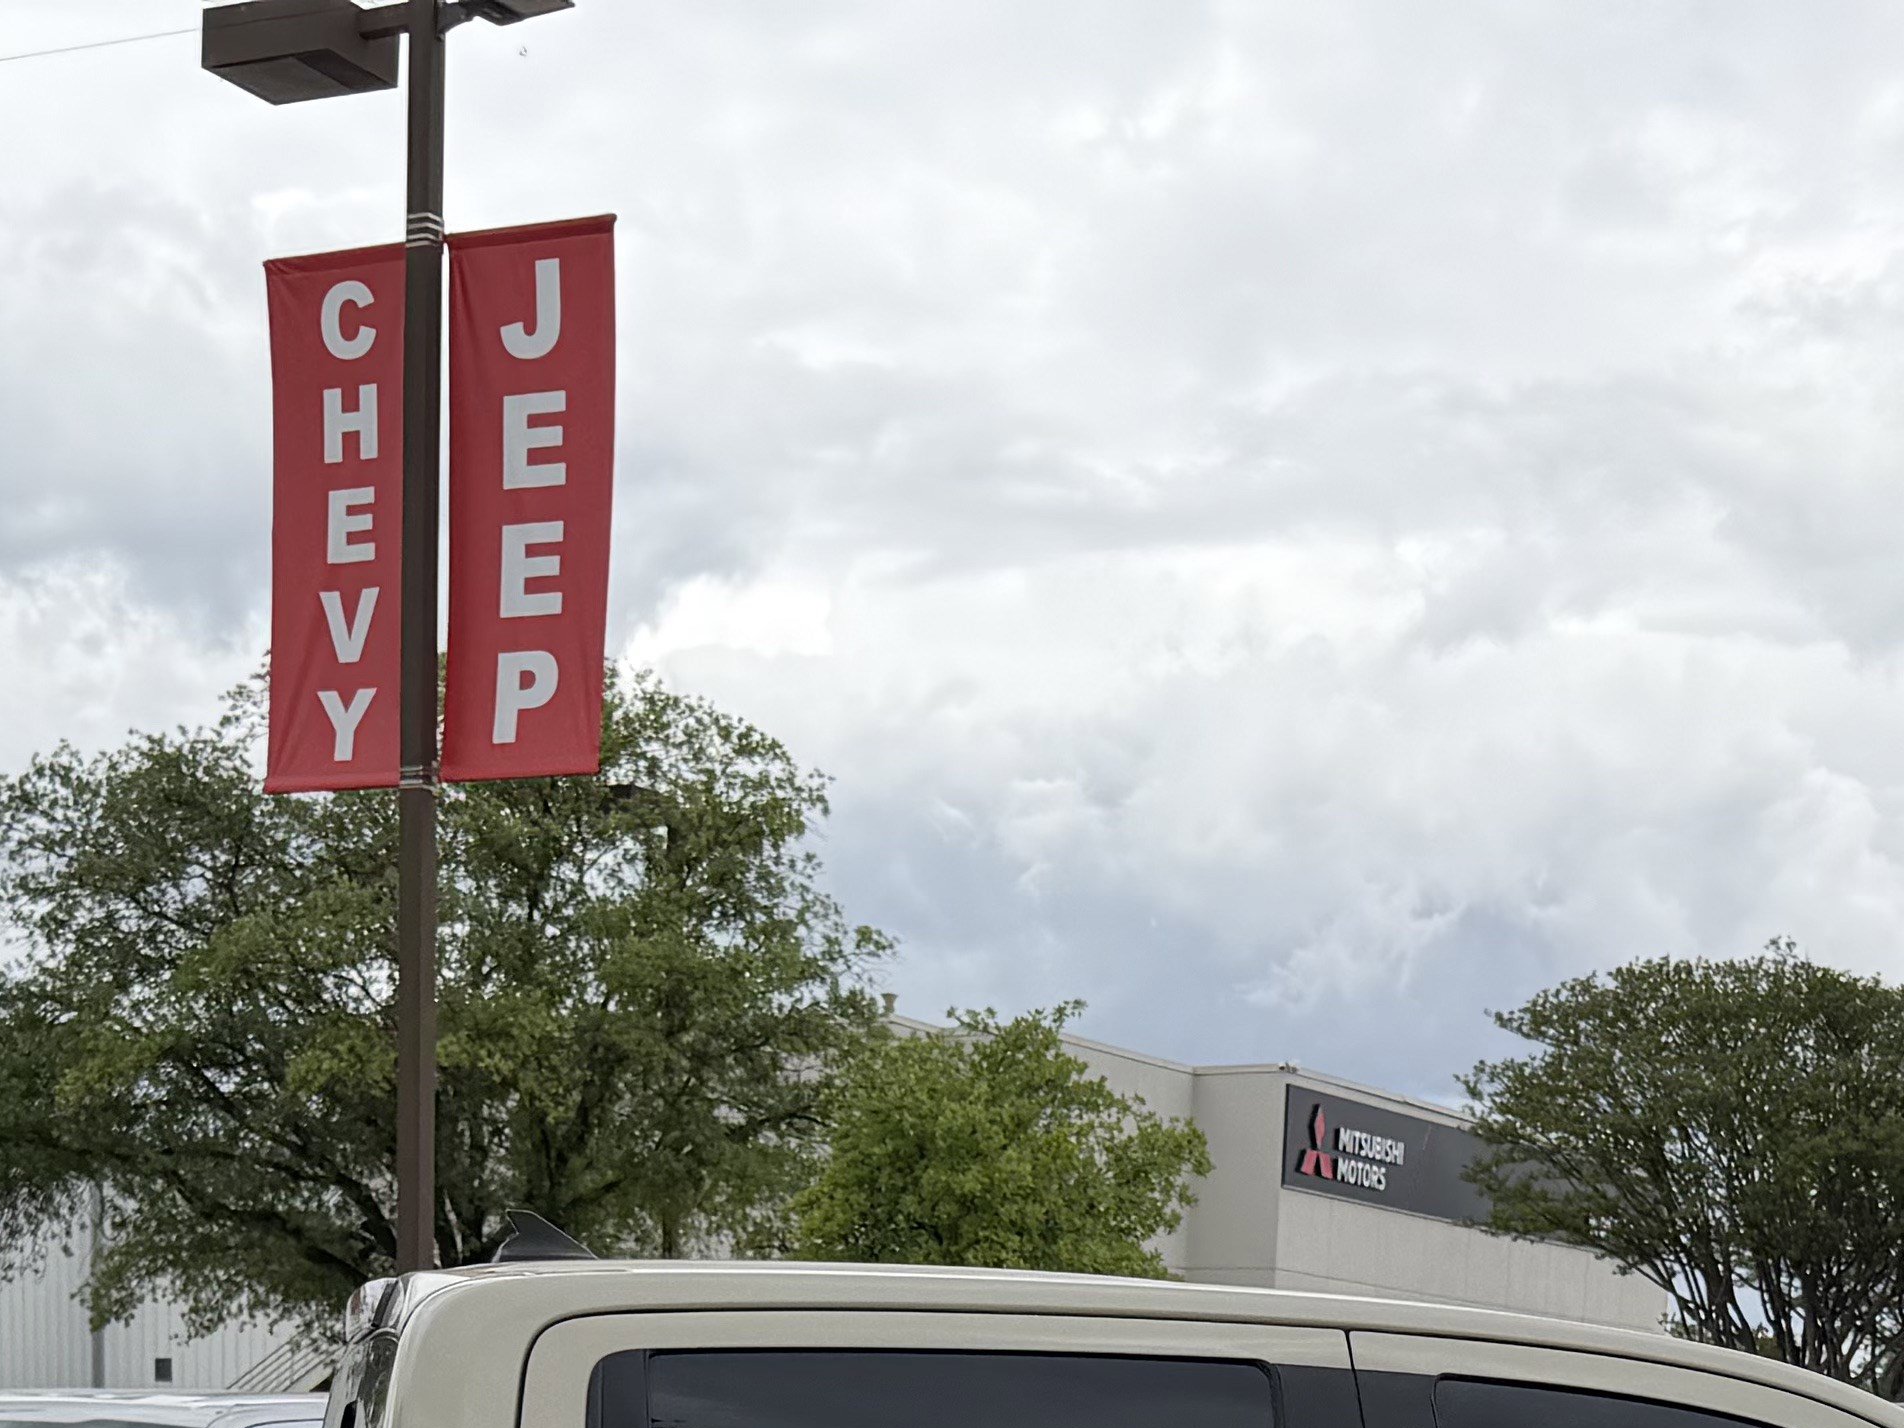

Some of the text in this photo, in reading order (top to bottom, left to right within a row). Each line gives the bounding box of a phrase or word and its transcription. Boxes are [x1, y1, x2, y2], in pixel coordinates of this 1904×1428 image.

[317, 280, 380, 761] CHEVY
[491, 257, 567, 743] JEEP
[1337, 1156, 1386, 1191] MOTORS
[1338, 1127, 1405, 1165] MITSUBISHI
